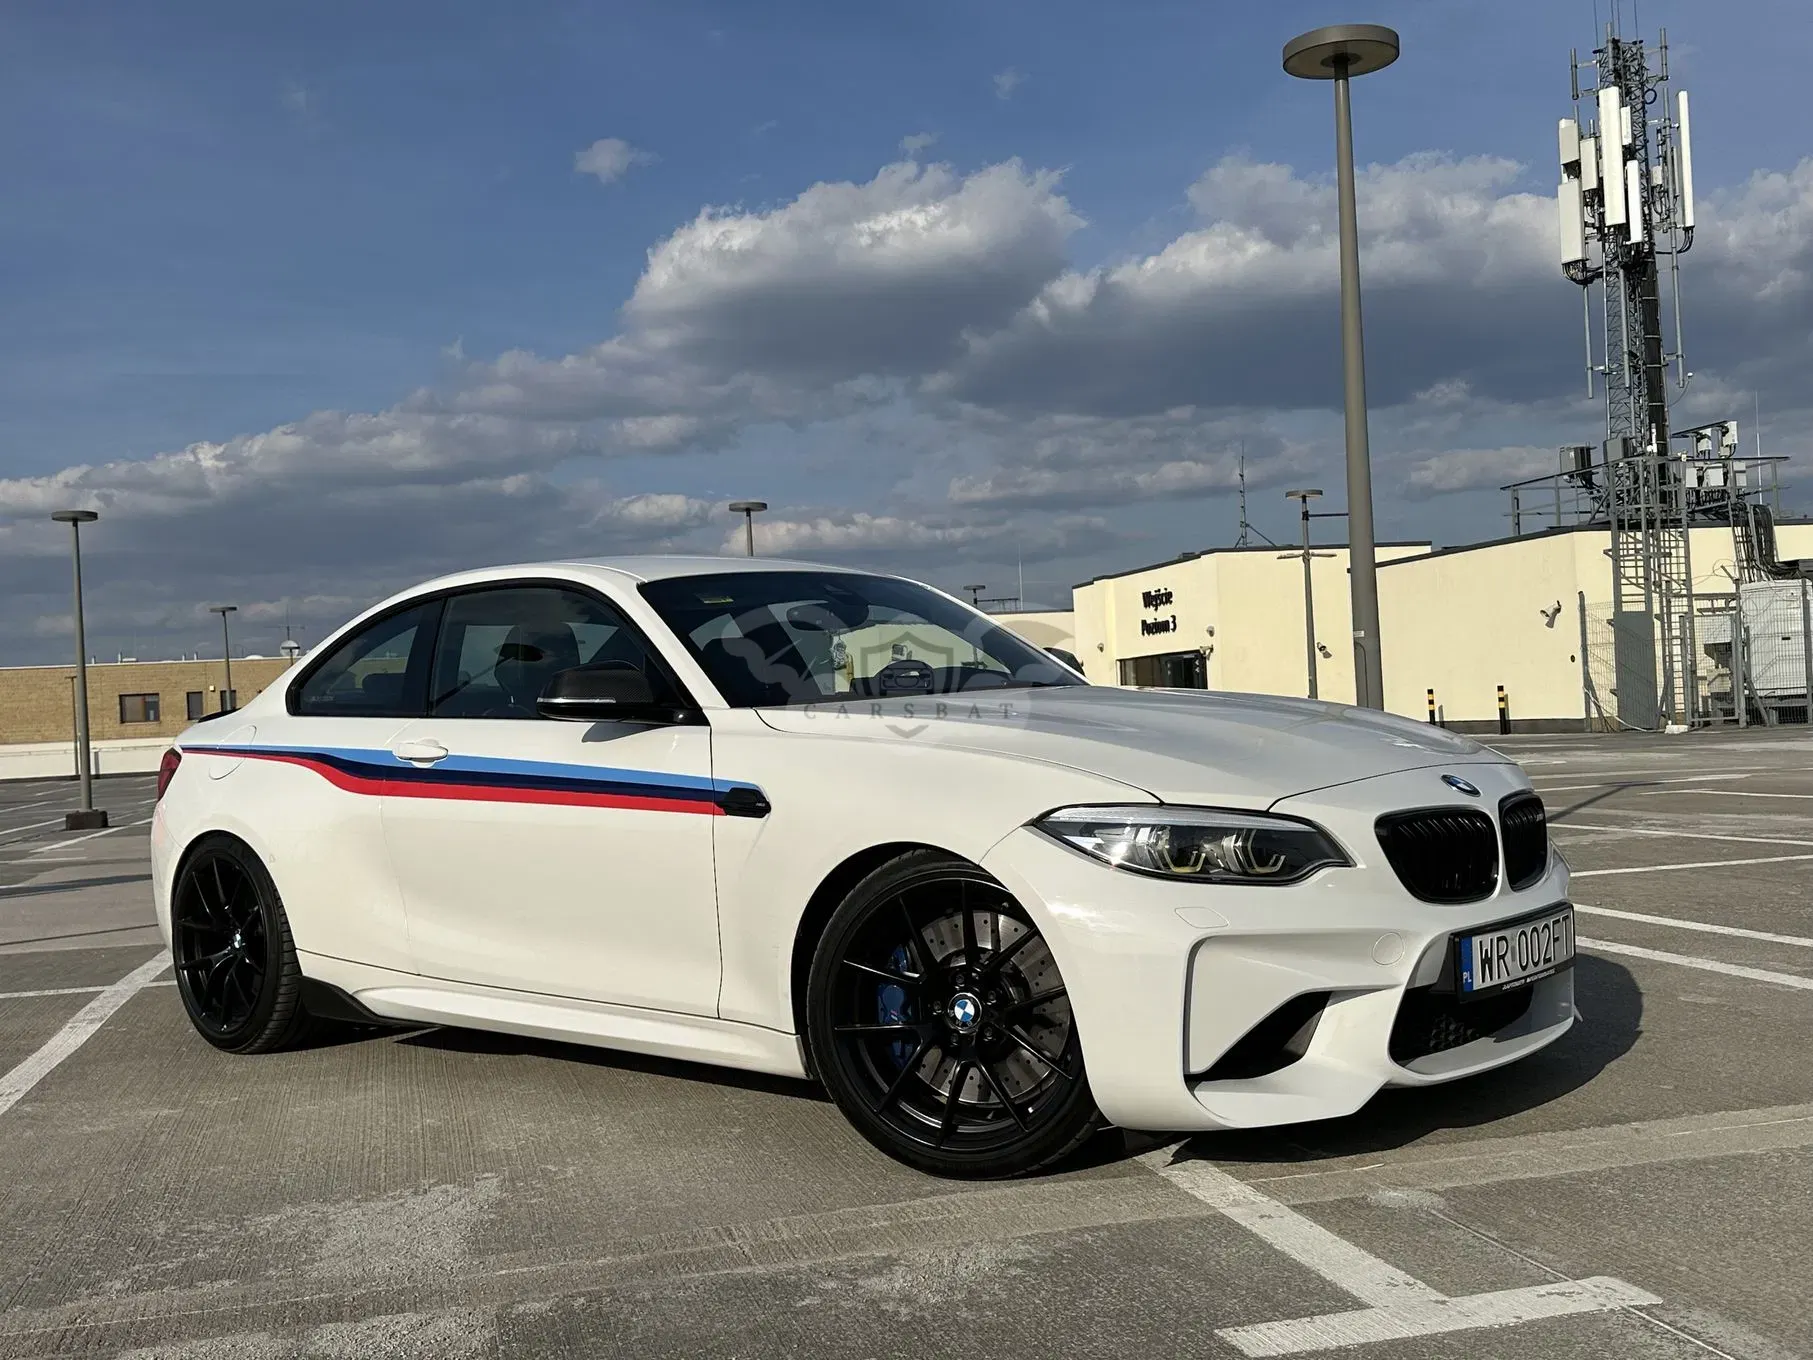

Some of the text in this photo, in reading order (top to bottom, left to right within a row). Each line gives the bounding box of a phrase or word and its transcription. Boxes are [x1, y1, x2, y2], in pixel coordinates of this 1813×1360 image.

[1141, 614, 1177, 636] Poziom 3
[1478, 935, 1510, 984] WR
[1517, 914, 1569, 972] 002FT
[1463, 972, 1472, 984] PL
